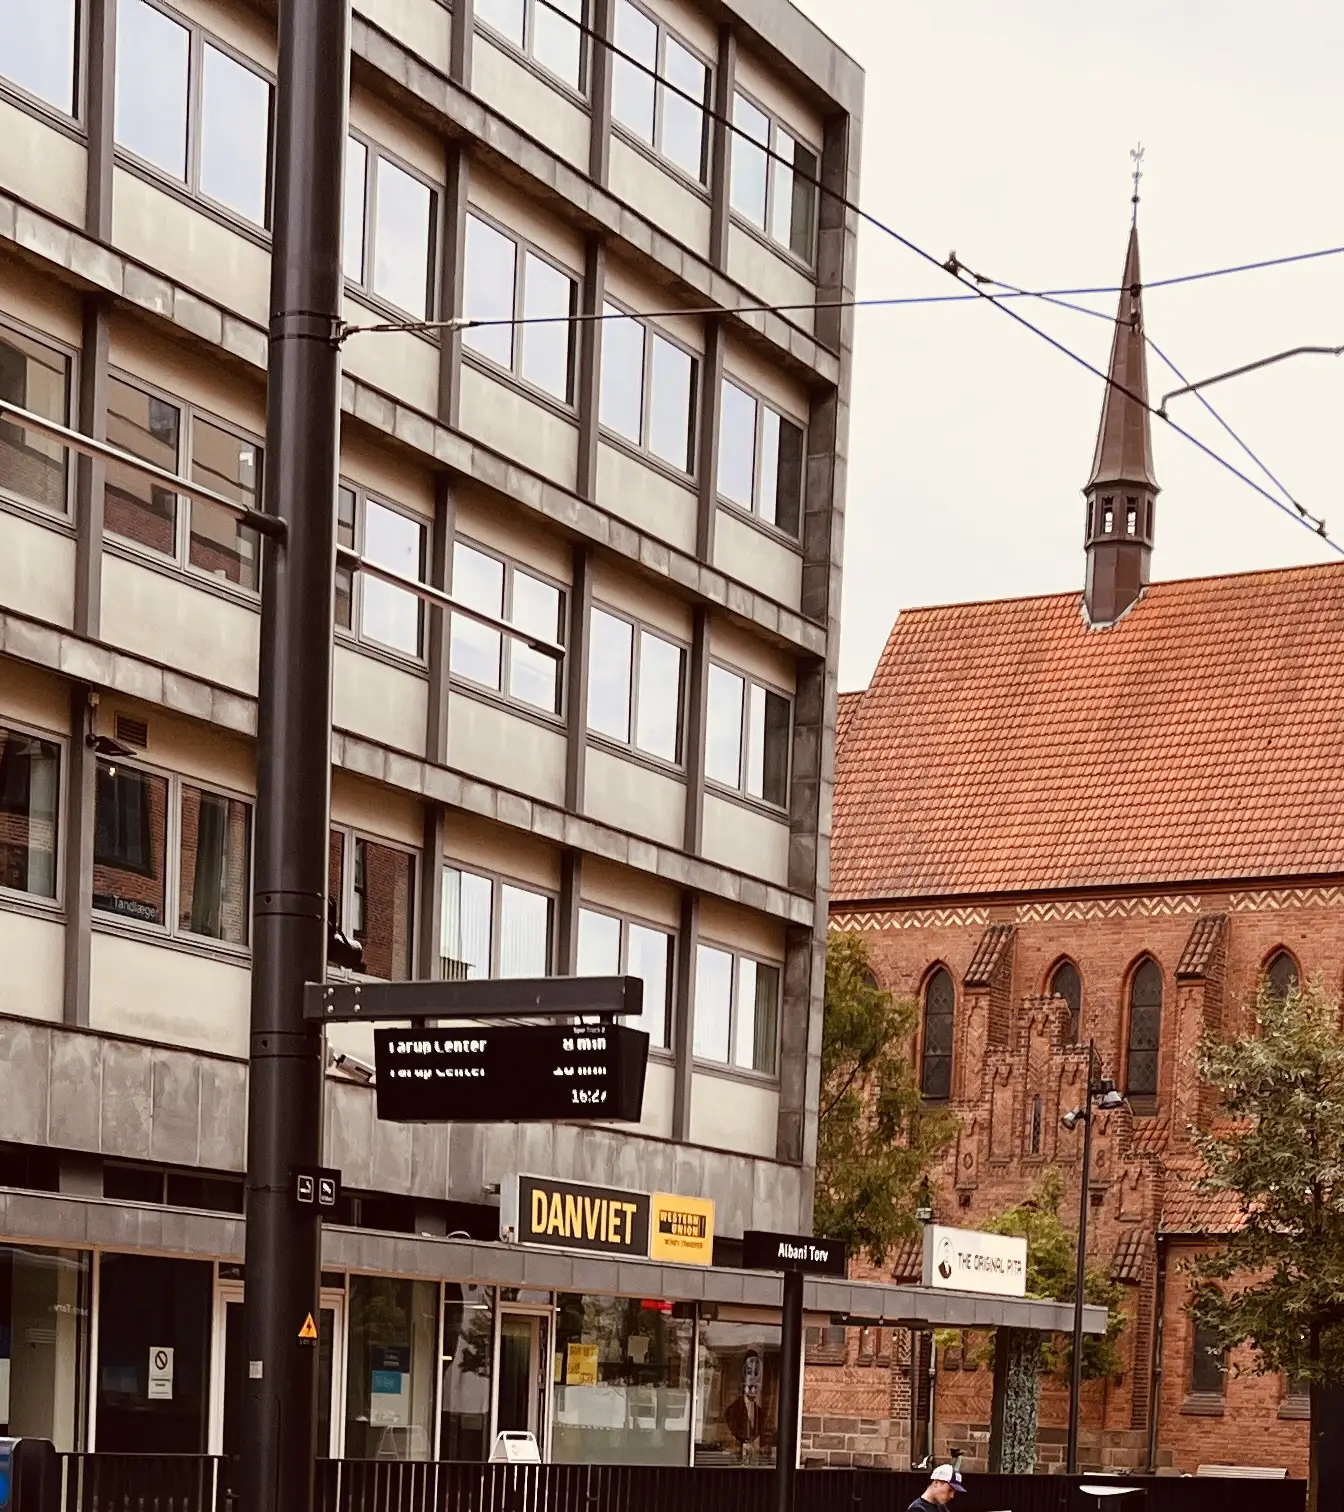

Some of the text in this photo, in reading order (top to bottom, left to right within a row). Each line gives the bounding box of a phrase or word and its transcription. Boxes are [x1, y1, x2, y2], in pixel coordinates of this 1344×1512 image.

[530, 1188, 637, 1246] DANVIET
[660, 1211, 699, 1225] WESTERN
[671, 1223, 699, 1237] UNION
[777, 1242, 829, 1262] Albani Torv
[958, 1252, 972, 1271] THE
